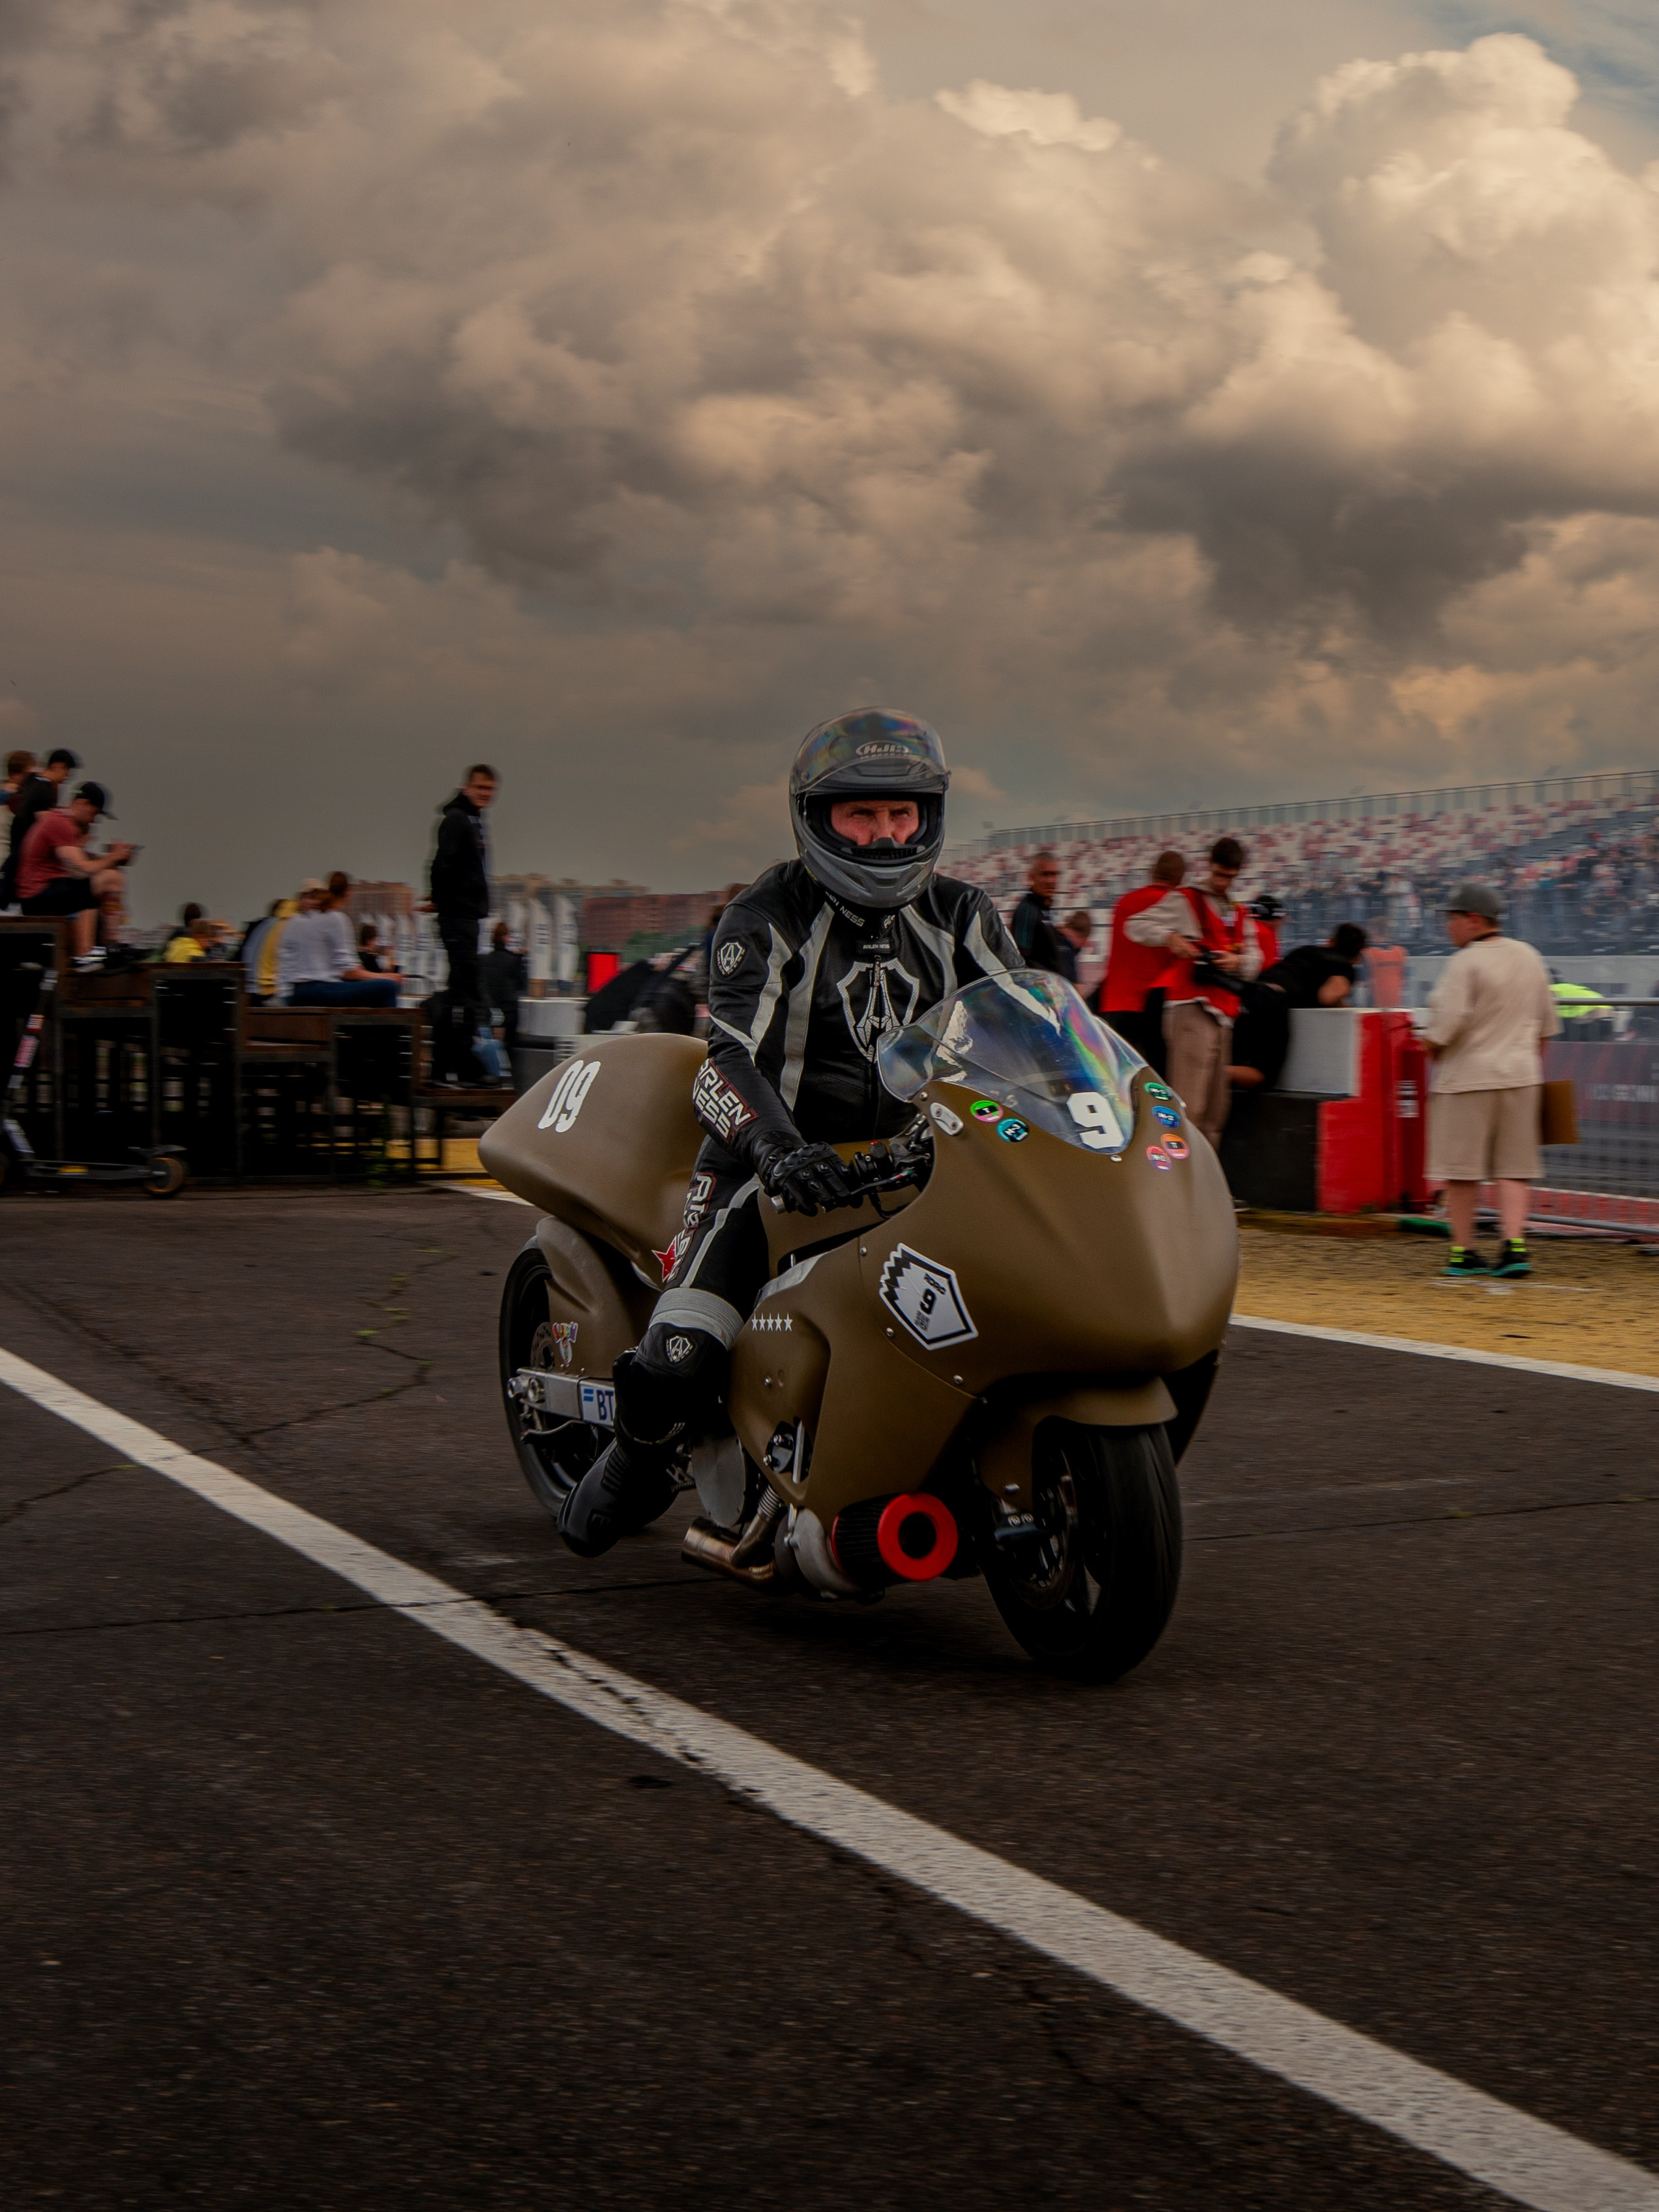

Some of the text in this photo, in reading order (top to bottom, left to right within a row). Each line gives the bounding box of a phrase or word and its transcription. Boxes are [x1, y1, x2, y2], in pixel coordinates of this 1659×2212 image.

[863, 744, 903, 755] HJC
[839, 906, 865, 927] NESS
[537, 1060, 601, 1133] 09
[692, 1077, 732, 1139] NESS
[698, 1058, 751, 1126] ARLEN
[1066, 1092, 1125, 1149] 9
[919, 1289, 936, 1315] 9
[596, 1389, 615, 1421] BT
